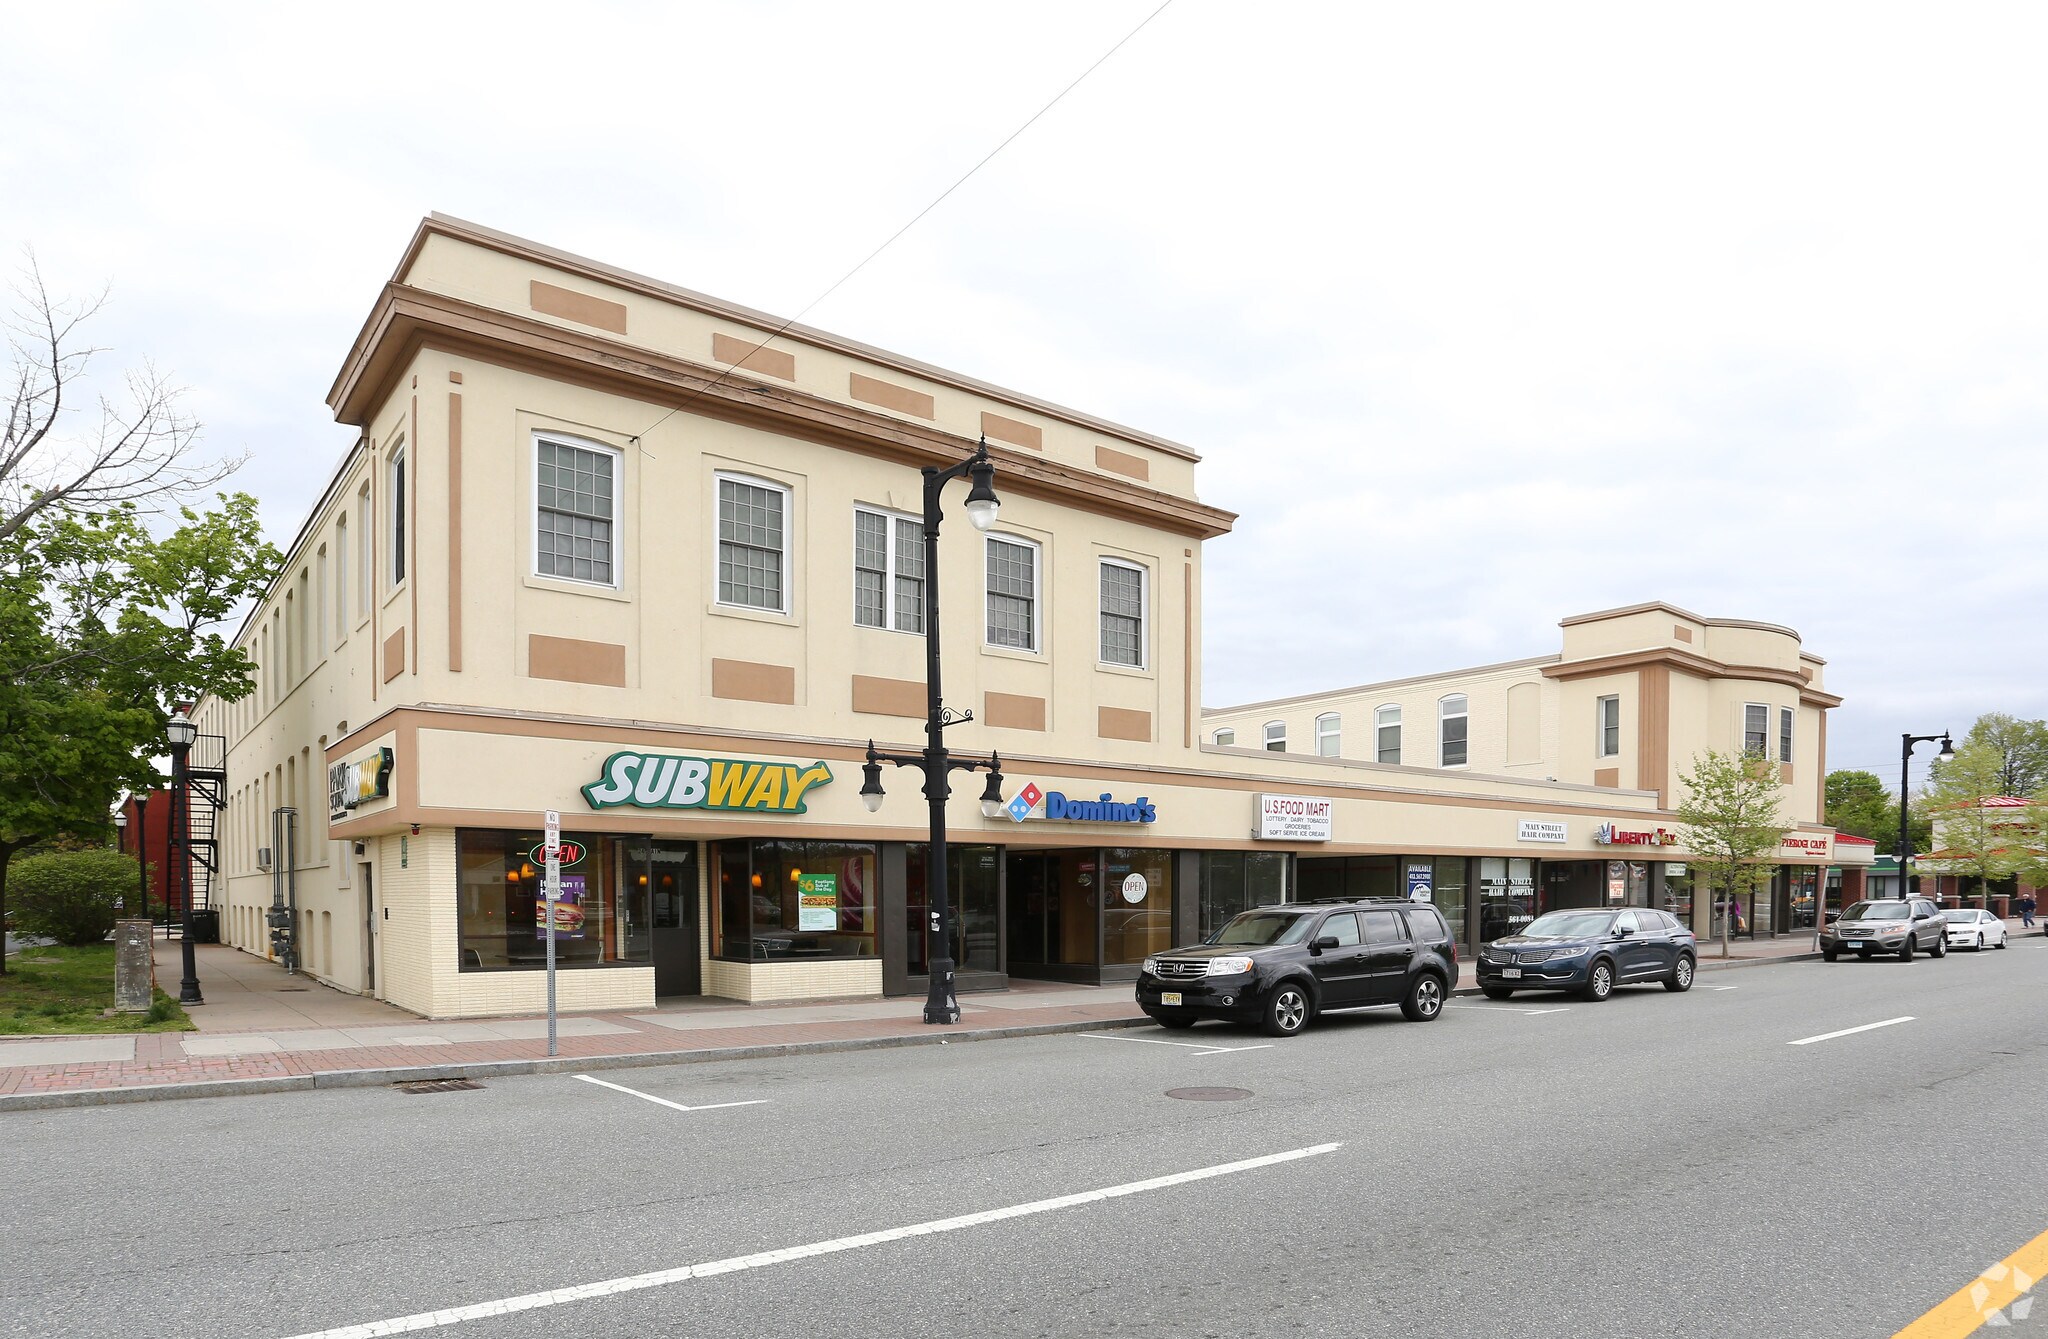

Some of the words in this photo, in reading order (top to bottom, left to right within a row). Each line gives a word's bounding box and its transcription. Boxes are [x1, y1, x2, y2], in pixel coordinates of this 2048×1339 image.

[330, 762, 346, 793] PARK
[344, 752, 383, 806] SUBWAY
[589, 755, 831, 810] SUBWAY
[1046, 792, 1156, 822] Domino's
[1306, 802, 1330, 816] MART
[550, 812, 556, 822] NO
[546, 822, 559, 831] PARKING
[1611, 825, 1655, 845] LIBERTY
[1782, 838, 1808, 848] PIEROGI
[1810, 837, 1827, 849] CAFÉ
[539, 845, 578, 863] OEN
[800, 880, 814, 892] $6
[1124, 882, 1144, 892] OPEN
[1508, 888, 1534, 896] COMPANY
